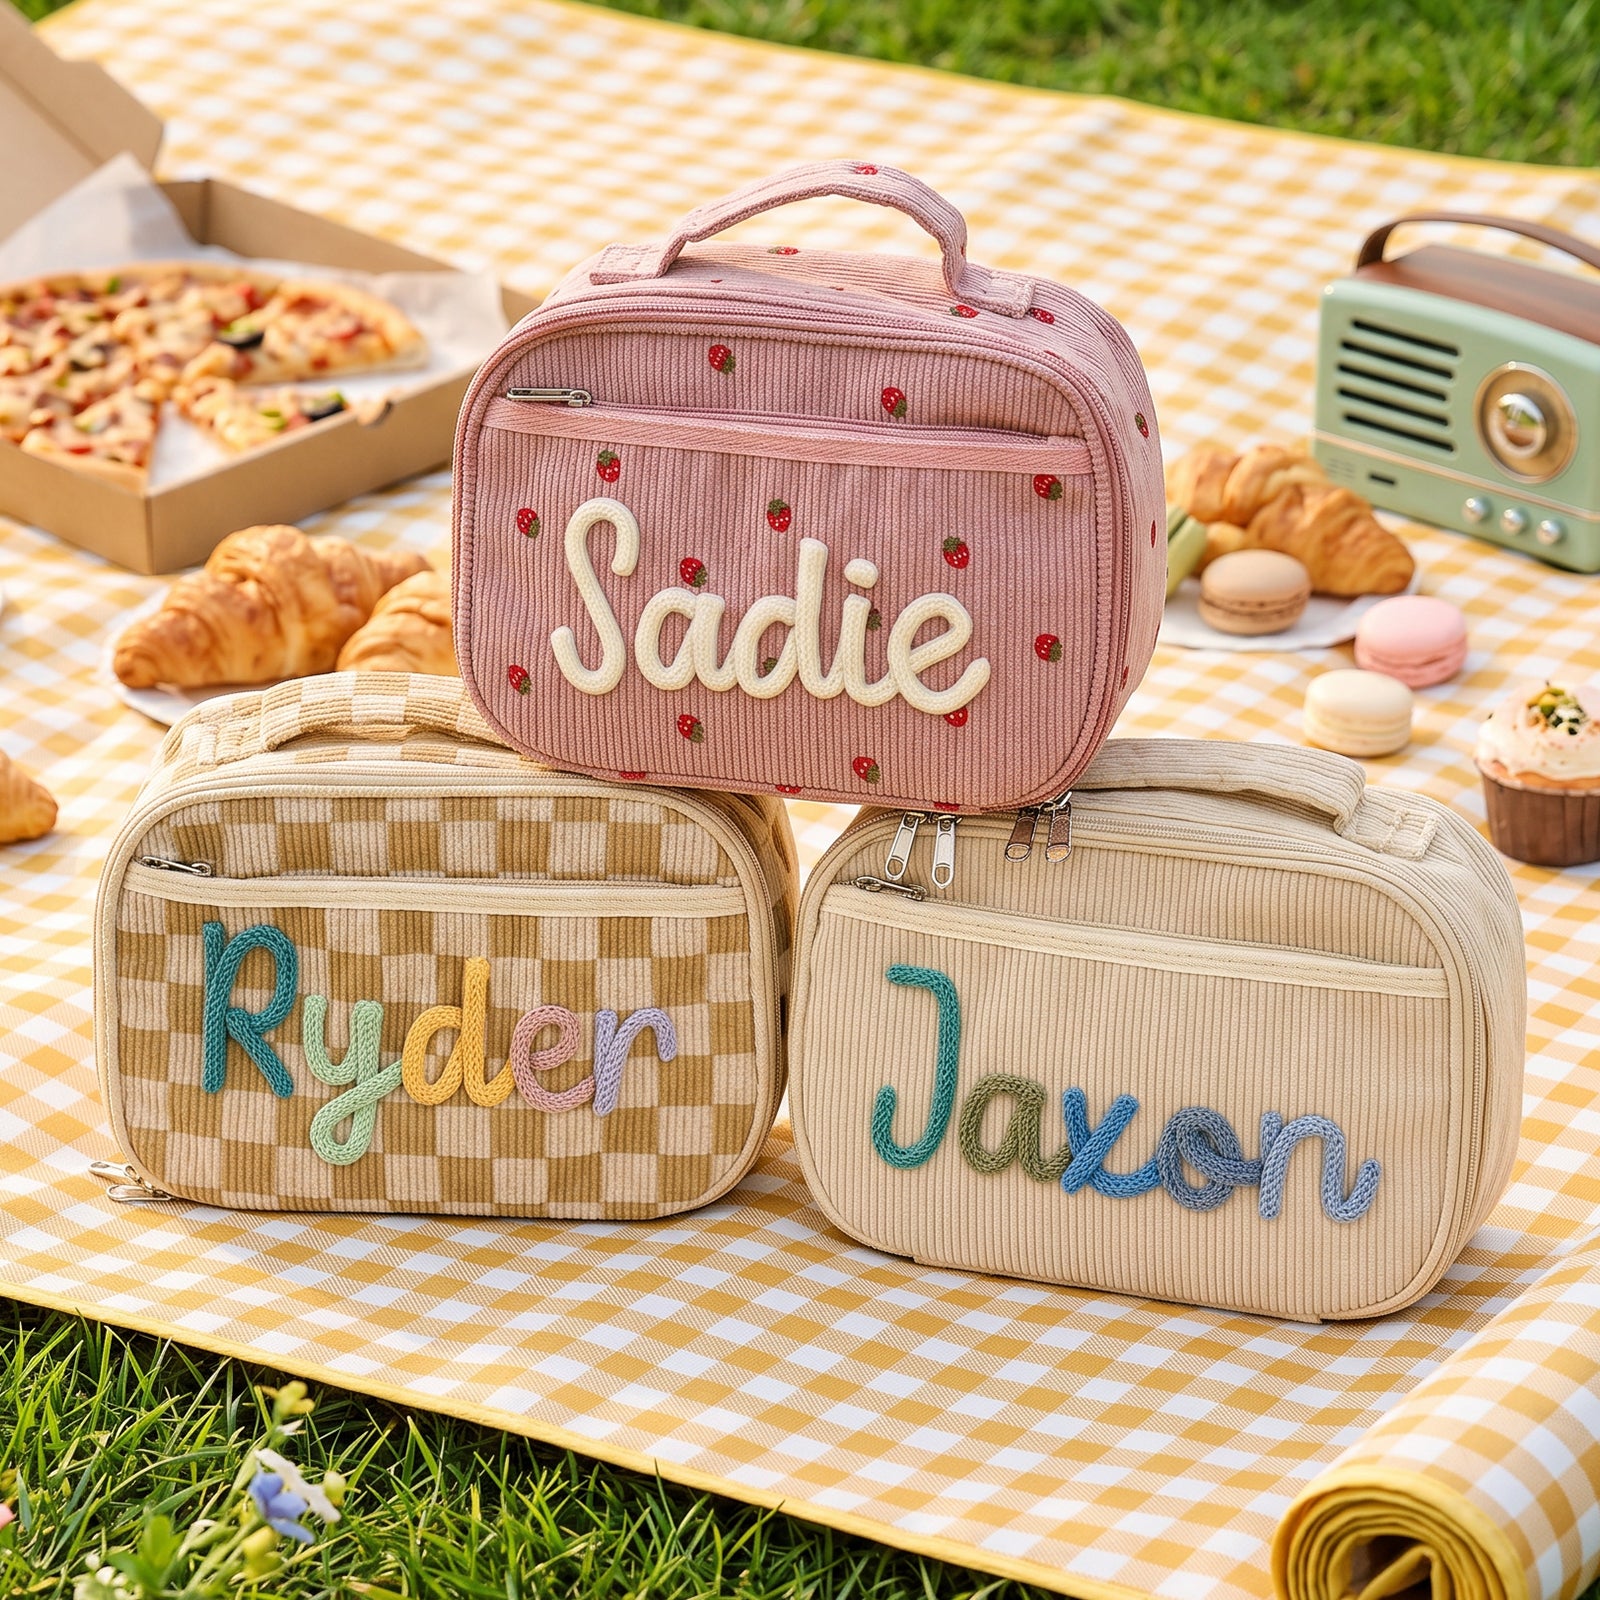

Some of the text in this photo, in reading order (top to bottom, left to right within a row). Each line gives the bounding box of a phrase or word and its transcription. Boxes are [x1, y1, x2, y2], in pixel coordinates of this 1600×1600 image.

[550, 497, 991, 715] Sadie
[202, 920, 677, 1166] Ryder
[871, 964, 1382, 1223] Jaxon
